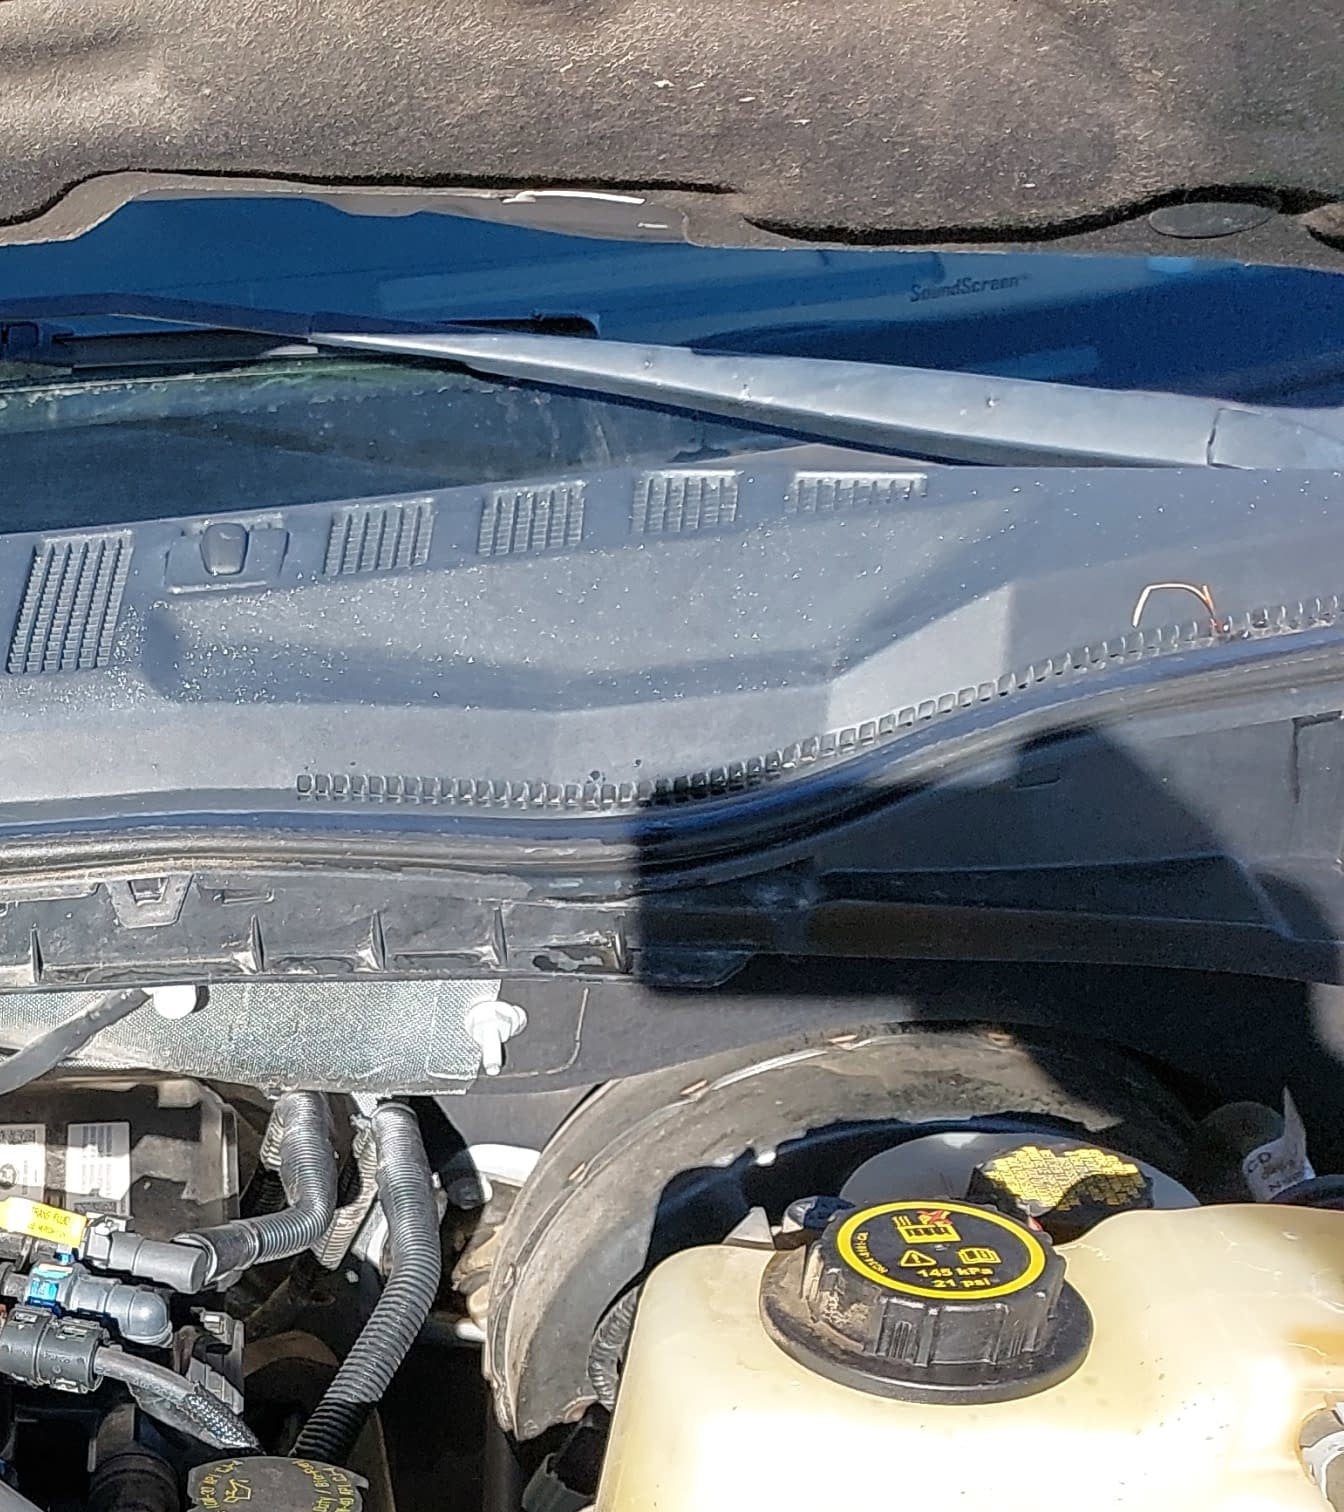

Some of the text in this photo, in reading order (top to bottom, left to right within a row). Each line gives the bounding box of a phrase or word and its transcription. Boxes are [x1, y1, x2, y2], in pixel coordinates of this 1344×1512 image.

[911, 276, 1019, 302] SoundScreen
[917, 1267, 993, 1277] 145 kPa
[933, 1278, 991, 1288] 21 psi
